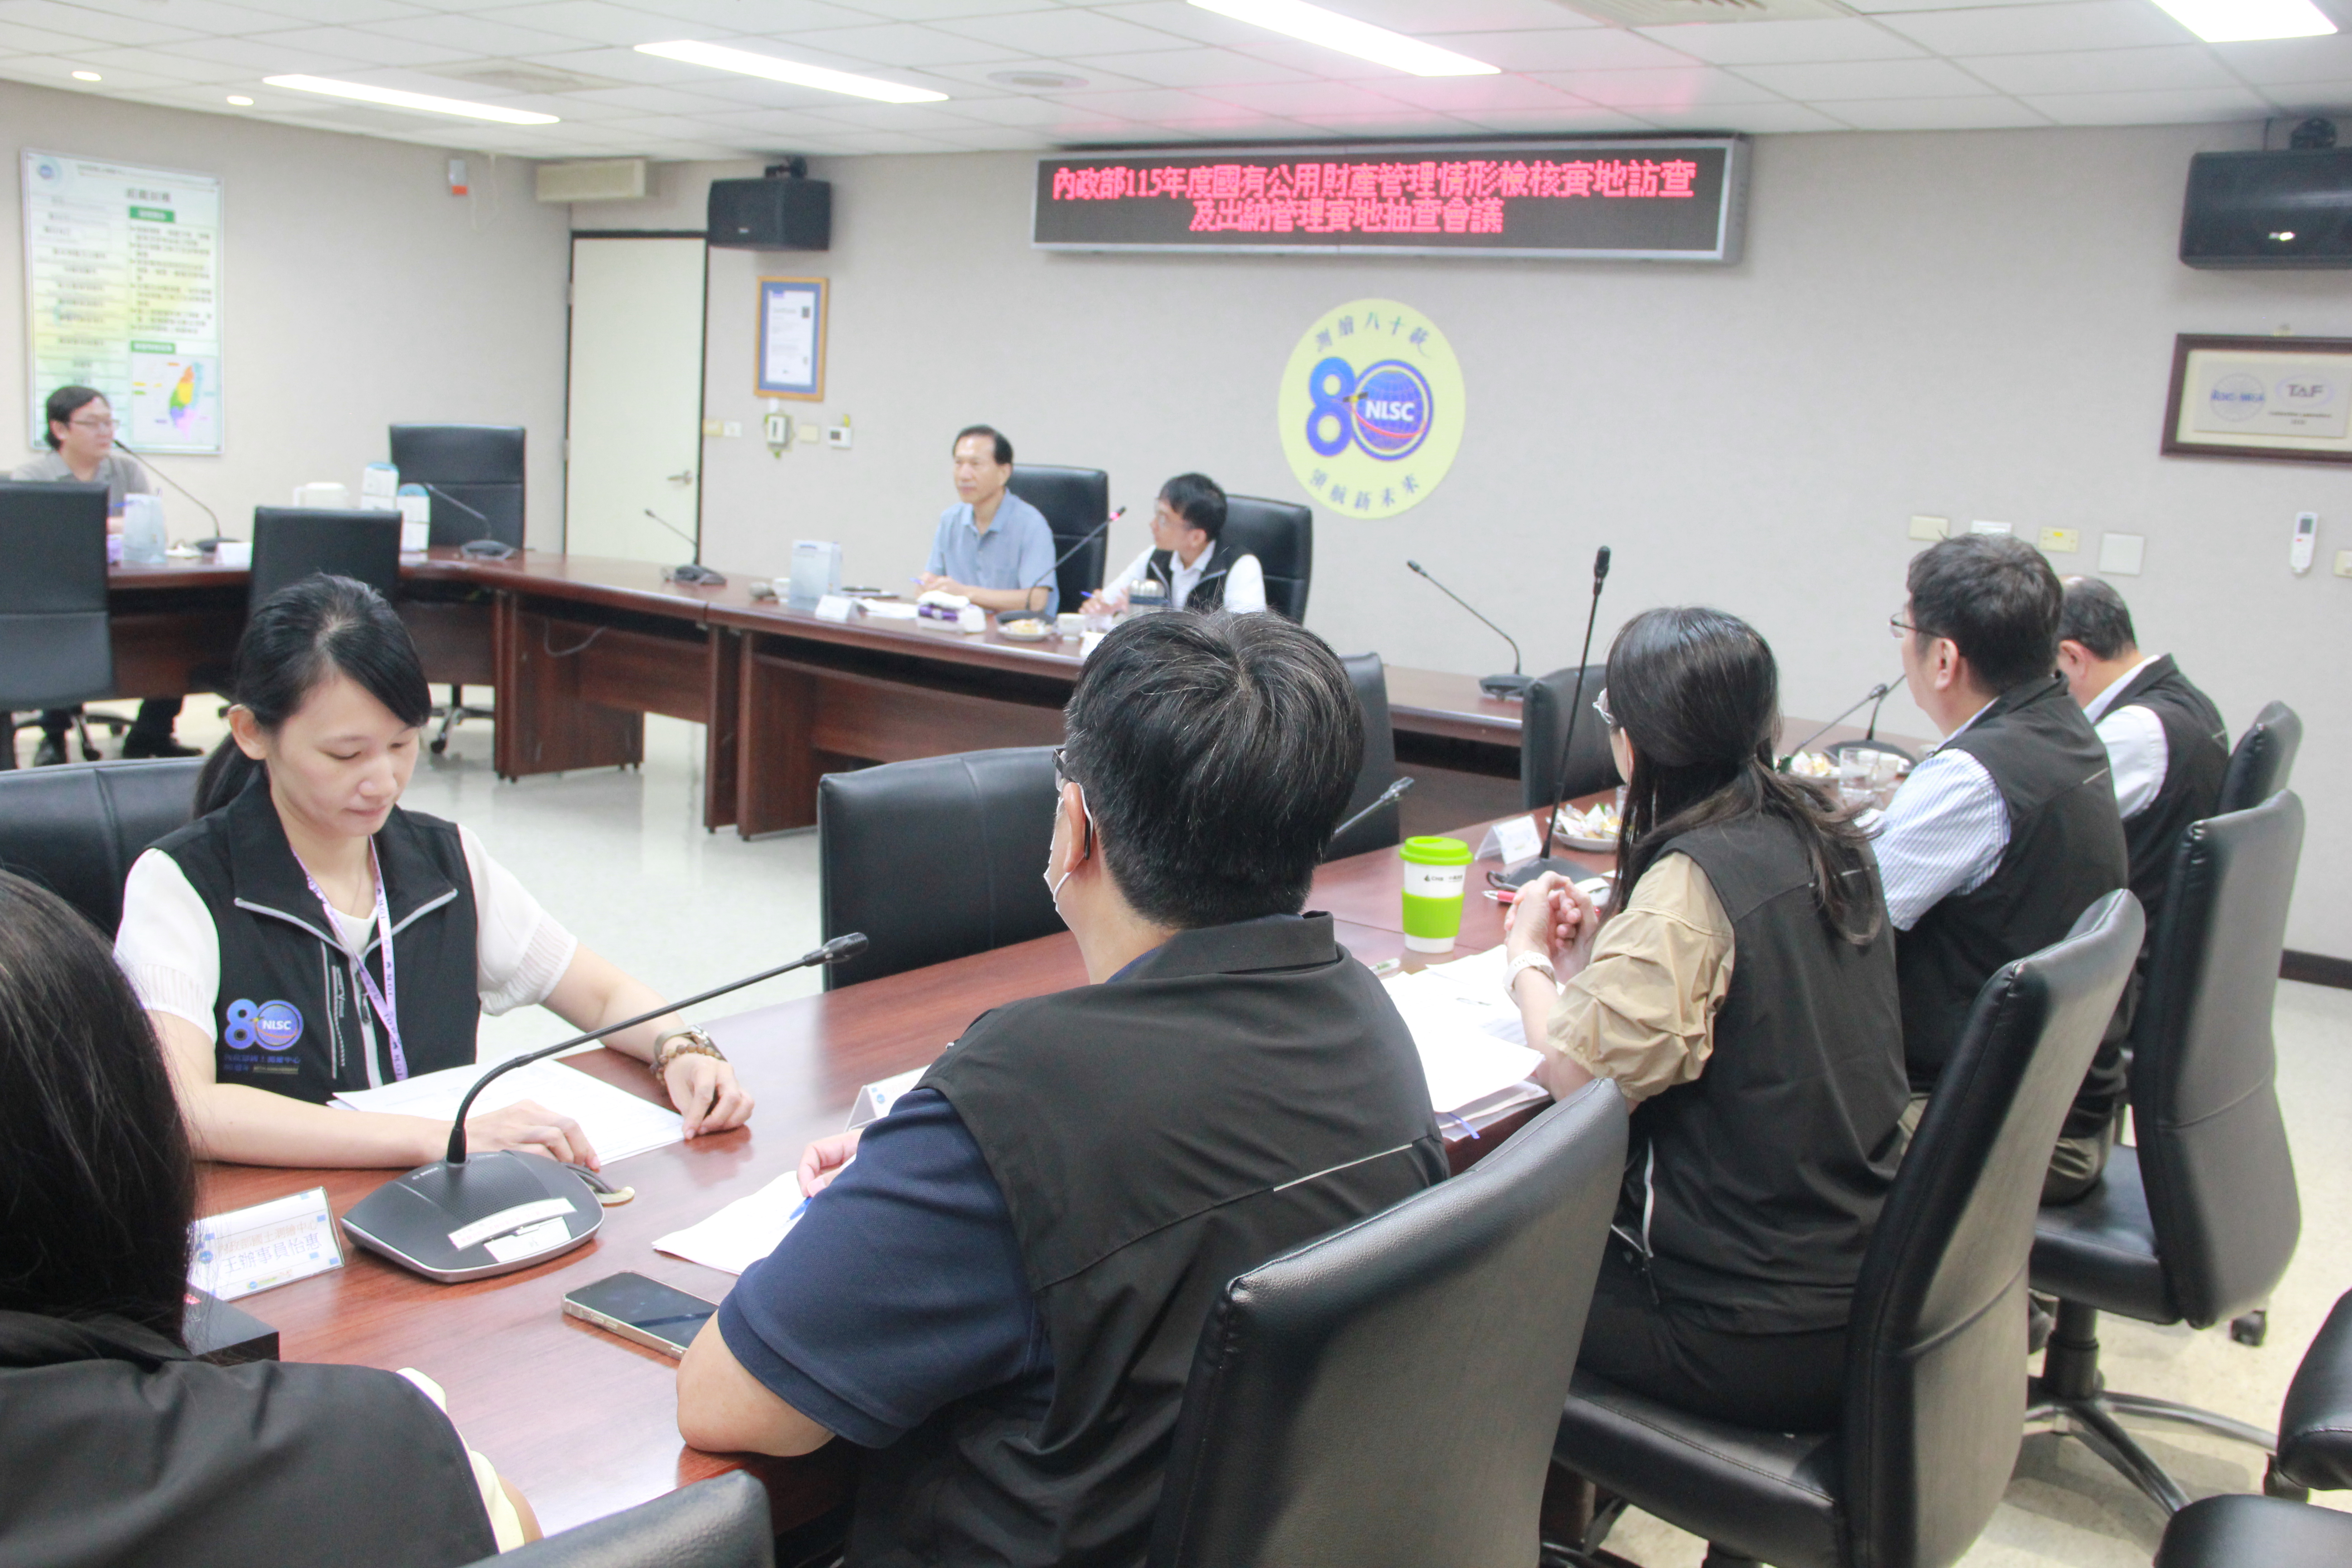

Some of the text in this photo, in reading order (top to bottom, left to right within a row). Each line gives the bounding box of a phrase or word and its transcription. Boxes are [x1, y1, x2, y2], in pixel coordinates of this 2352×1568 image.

[1189, 197, 1504, 233] 及出納管理實地抽查會議
[2287, 384, 2323, 397] TAF
[1365, 400, 1415, 422] NLSC
[262, 1019, 292, 1031] NLSC
[222, 1232, 322, 1274] 王辦事員怡惠
